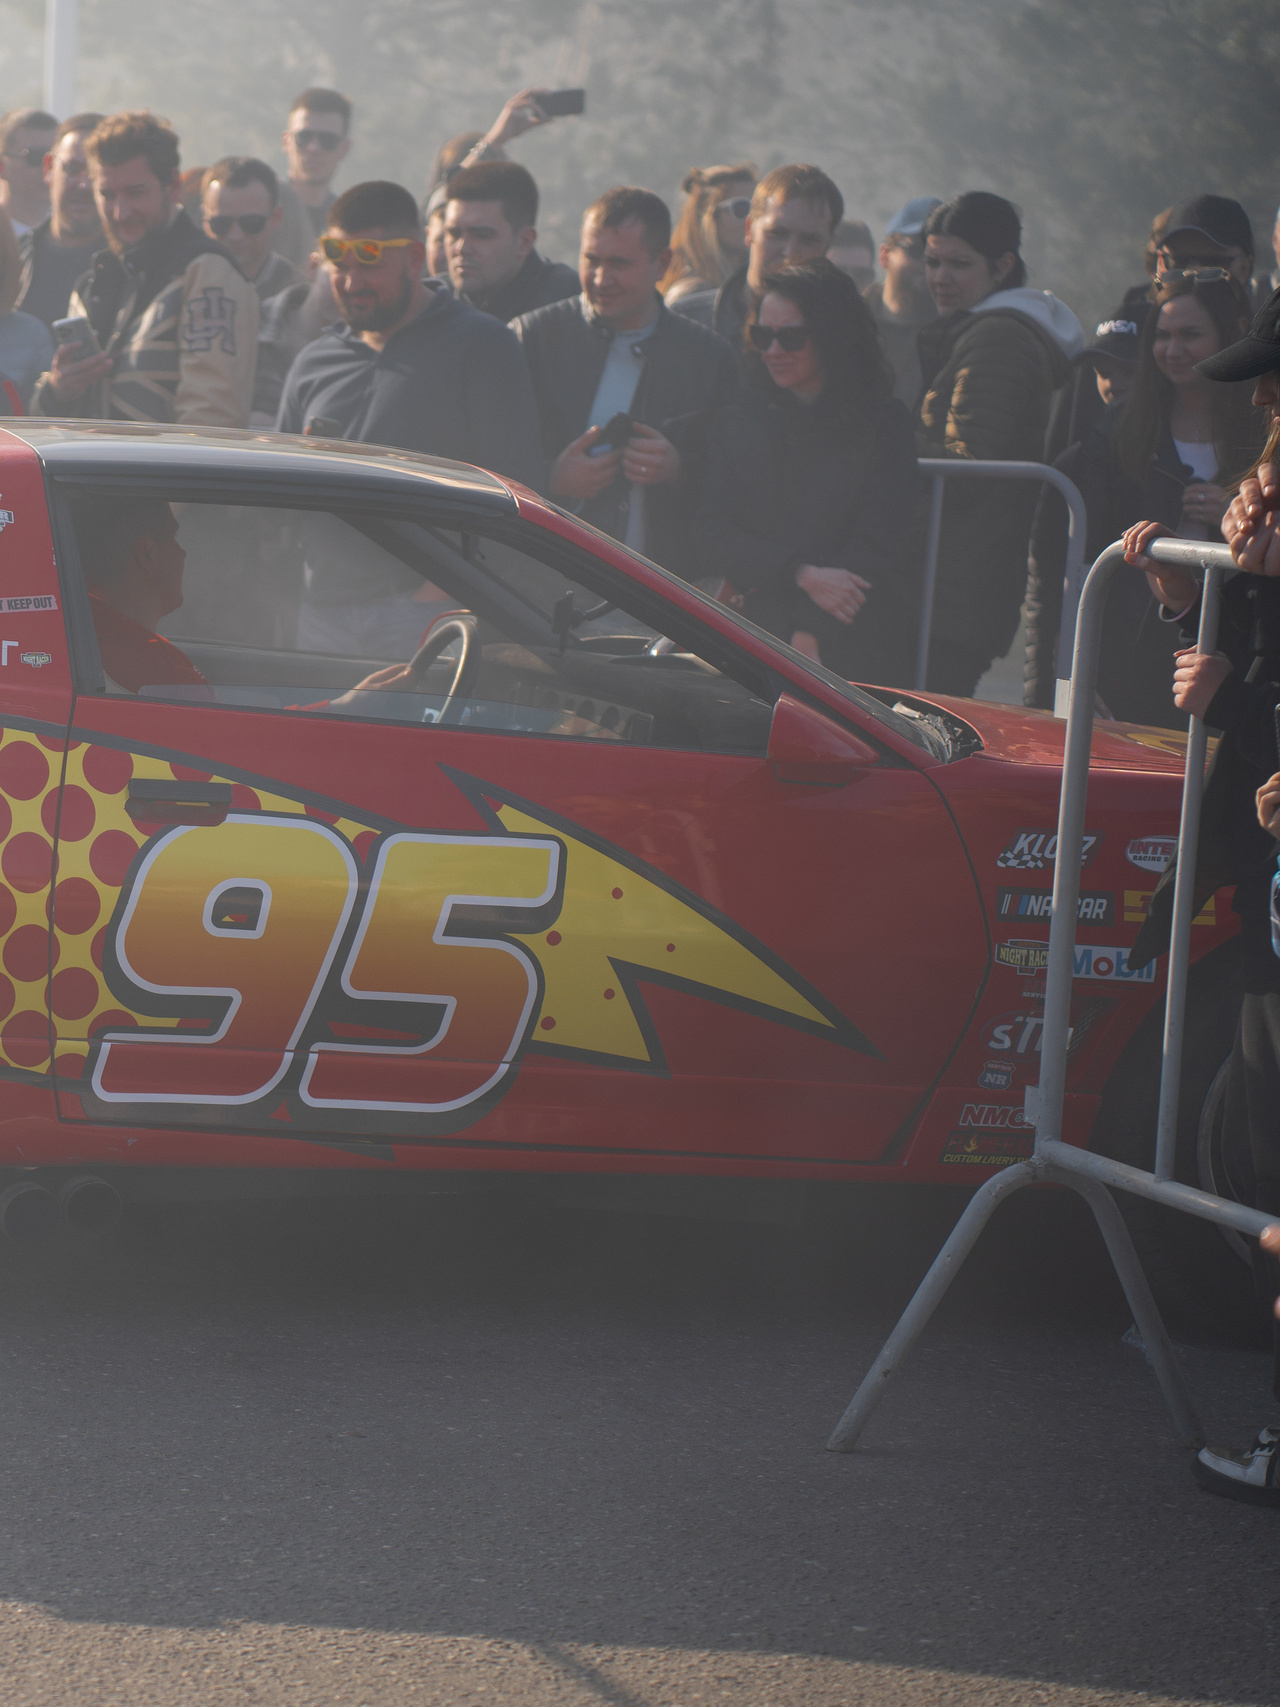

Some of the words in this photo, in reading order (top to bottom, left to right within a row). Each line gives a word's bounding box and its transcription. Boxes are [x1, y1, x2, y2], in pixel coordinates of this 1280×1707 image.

[1096, 320, 1138, 337] NASA
[8, 598, 33, 610] KEEP
[33, 597, 52, 609] OUT
[1013, 833, 1097, 859] KLOZ
[1026, 895, 1108, 919] NAAR
[92, 813, 561, 1114] 95
[1000, 947, 1028, 966] NIGHT
[1028, 949, 1050, 967] RAC
[988, 1016, 1043, 1054] ST
[984, 1074, 1008, 1085] NR
[959, 1104, 1036, 1129] NMC
[943, 1154, 981, 1164] CUSTOM
[982, 1156, 1016, 1165] LIVERY
